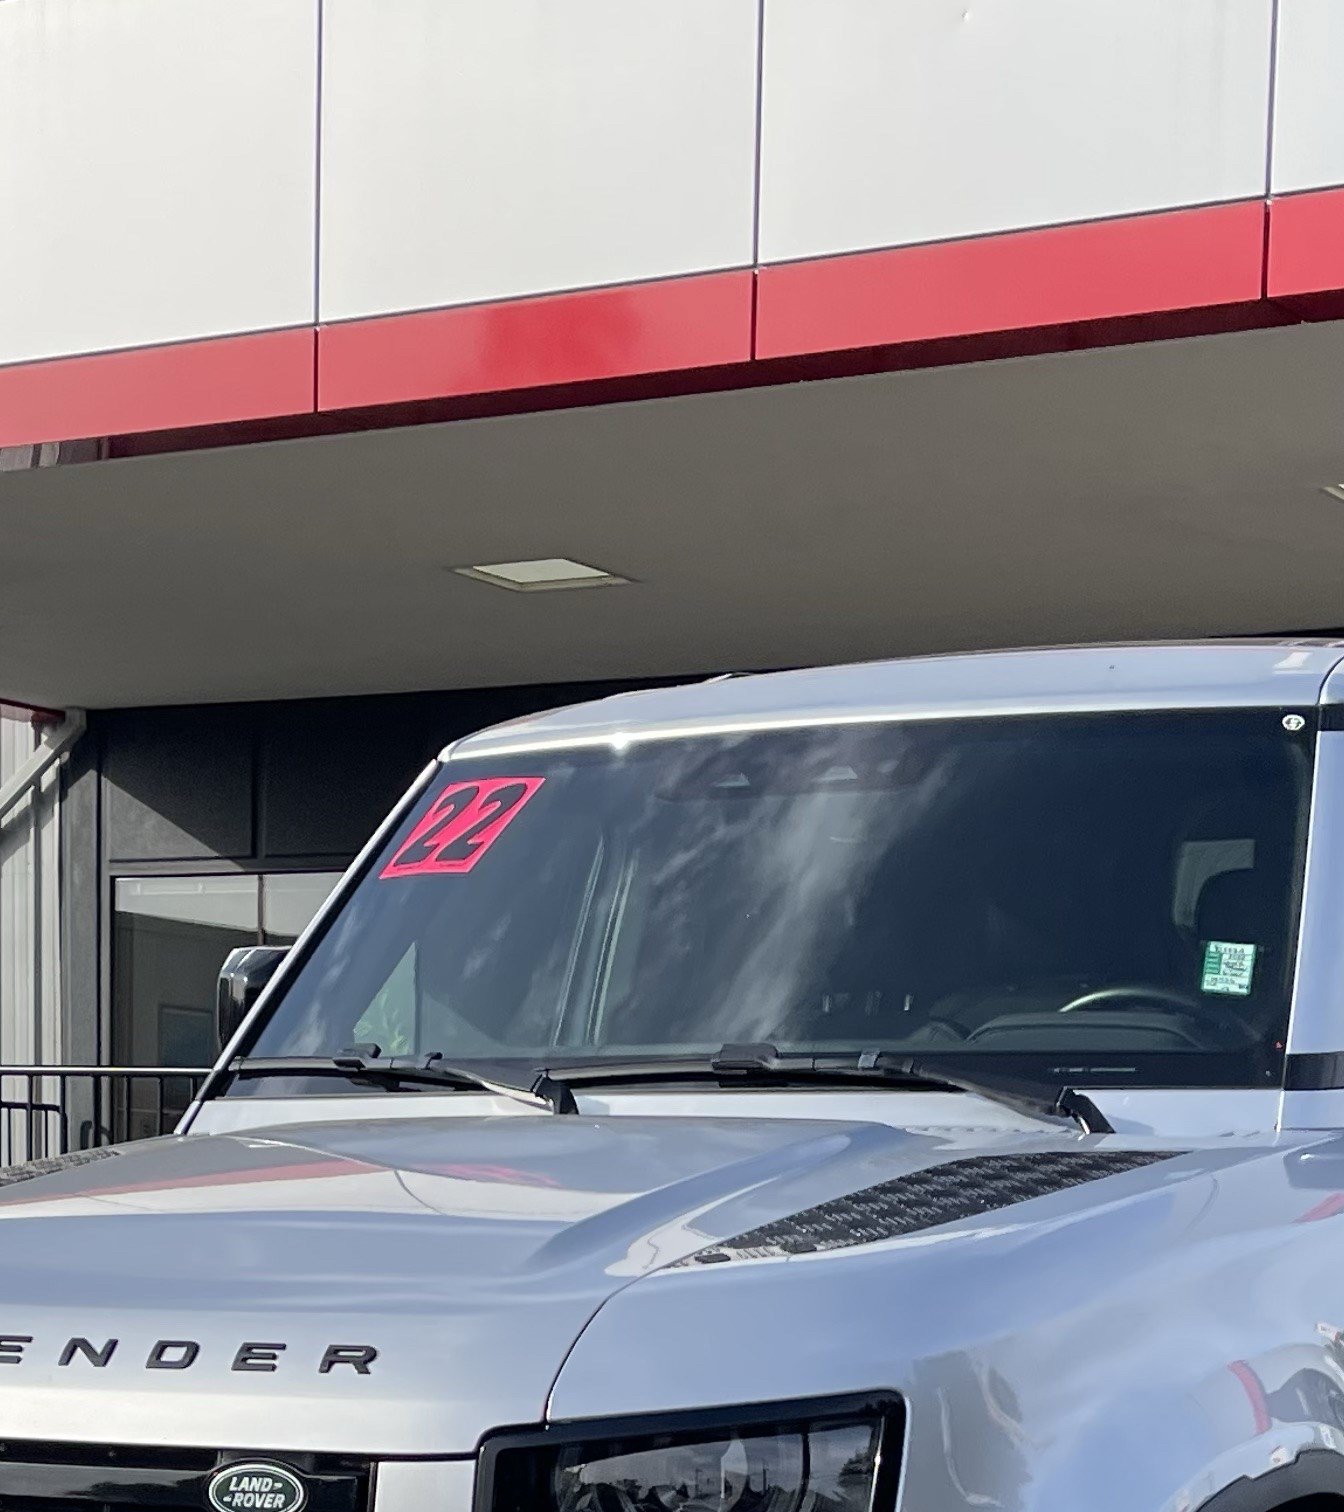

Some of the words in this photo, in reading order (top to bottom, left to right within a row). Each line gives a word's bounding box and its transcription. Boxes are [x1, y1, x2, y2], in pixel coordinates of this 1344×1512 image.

[394, 783, 528, 867] 22
[229, 1476, 273, 1492] LAND
[231, 1492, 286, 1508] ROVER
